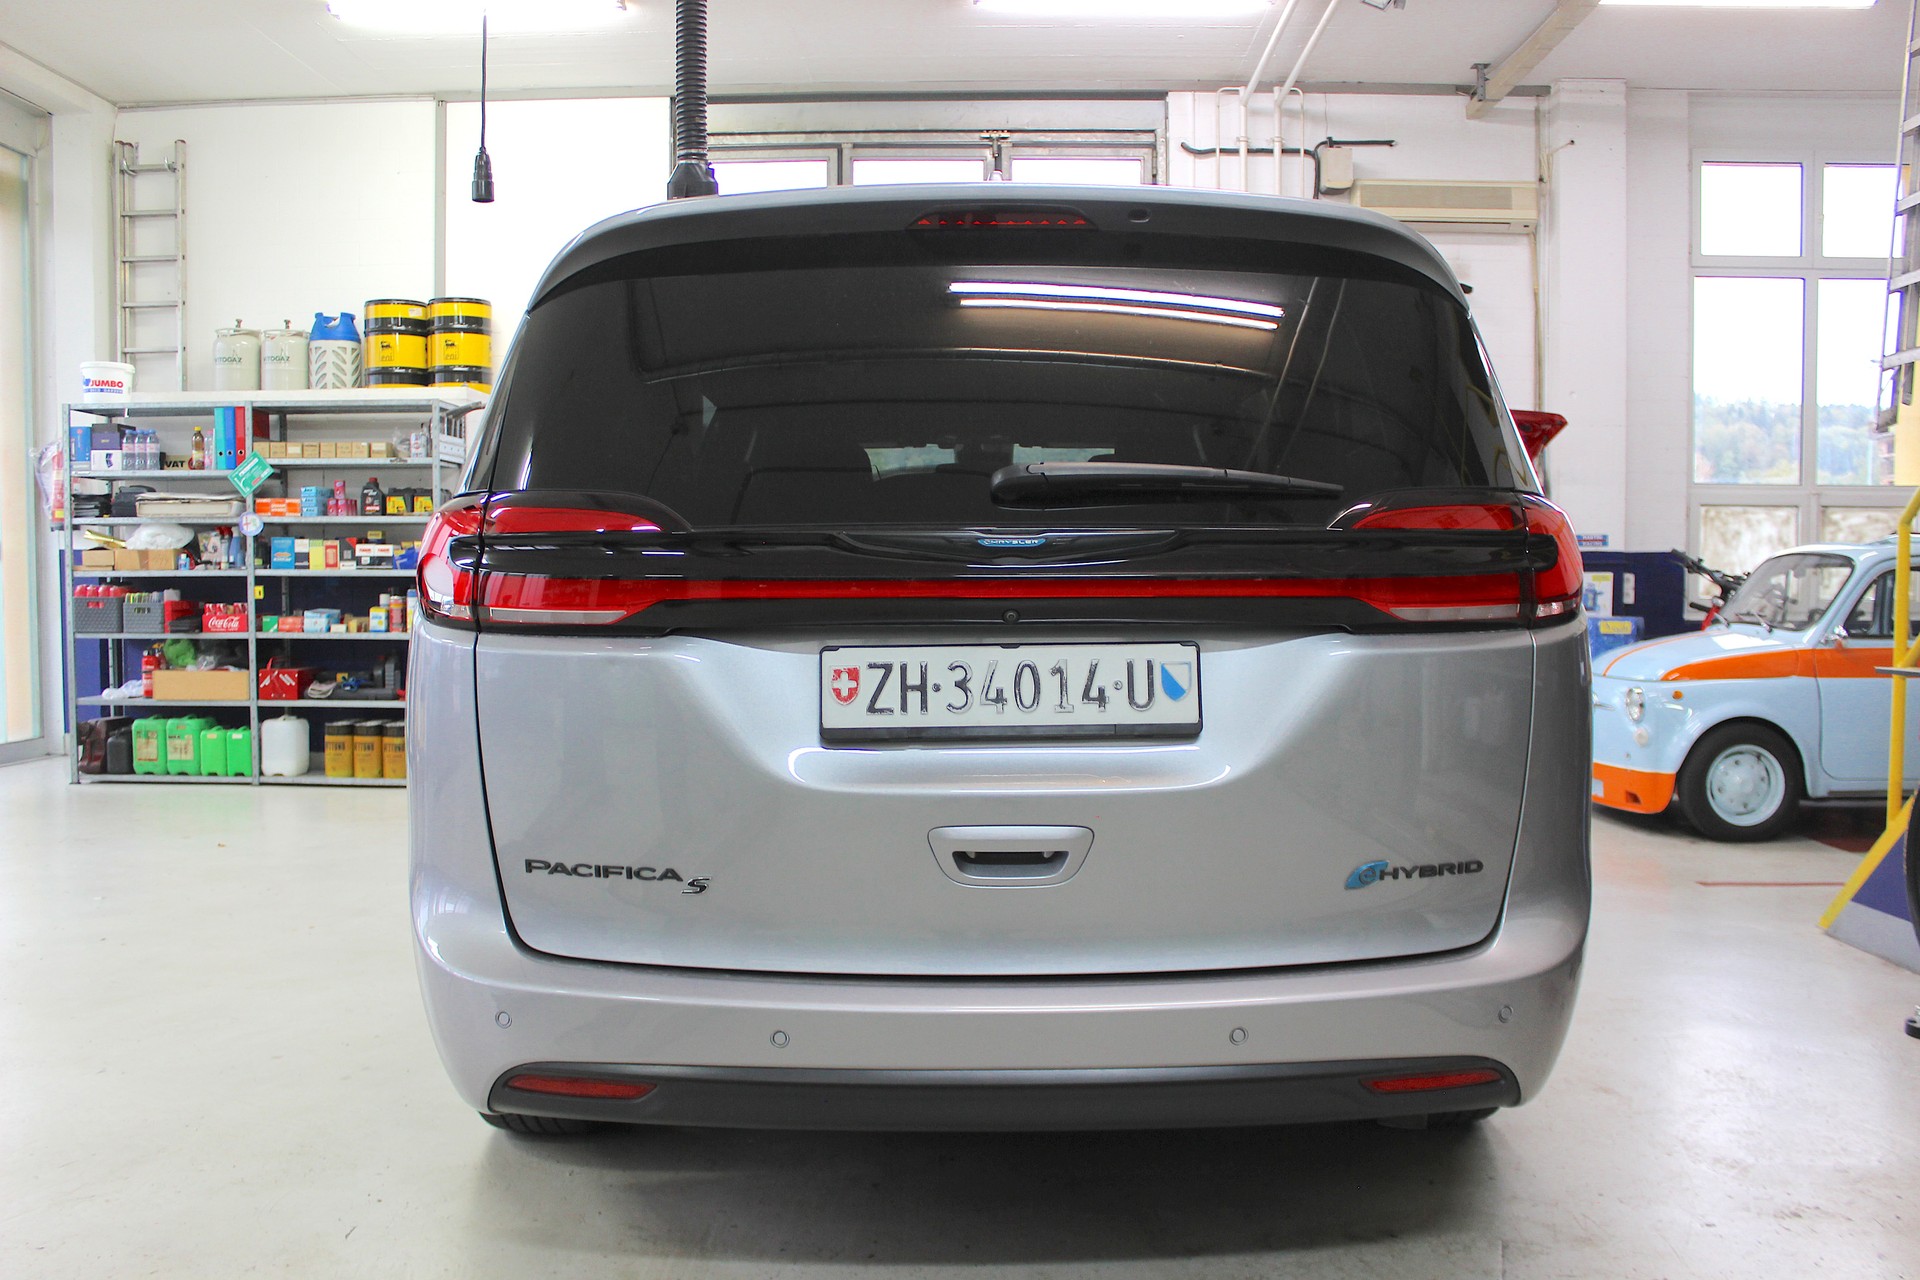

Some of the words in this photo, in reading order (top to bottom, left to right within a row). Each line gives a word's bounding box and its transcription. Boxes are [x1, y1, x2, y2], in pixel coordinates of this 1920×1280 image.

[91, 380, 123, 388] JUMBO
[525, 859, 684, 882] PACIFICA
[681, 876, 712, 896] S
